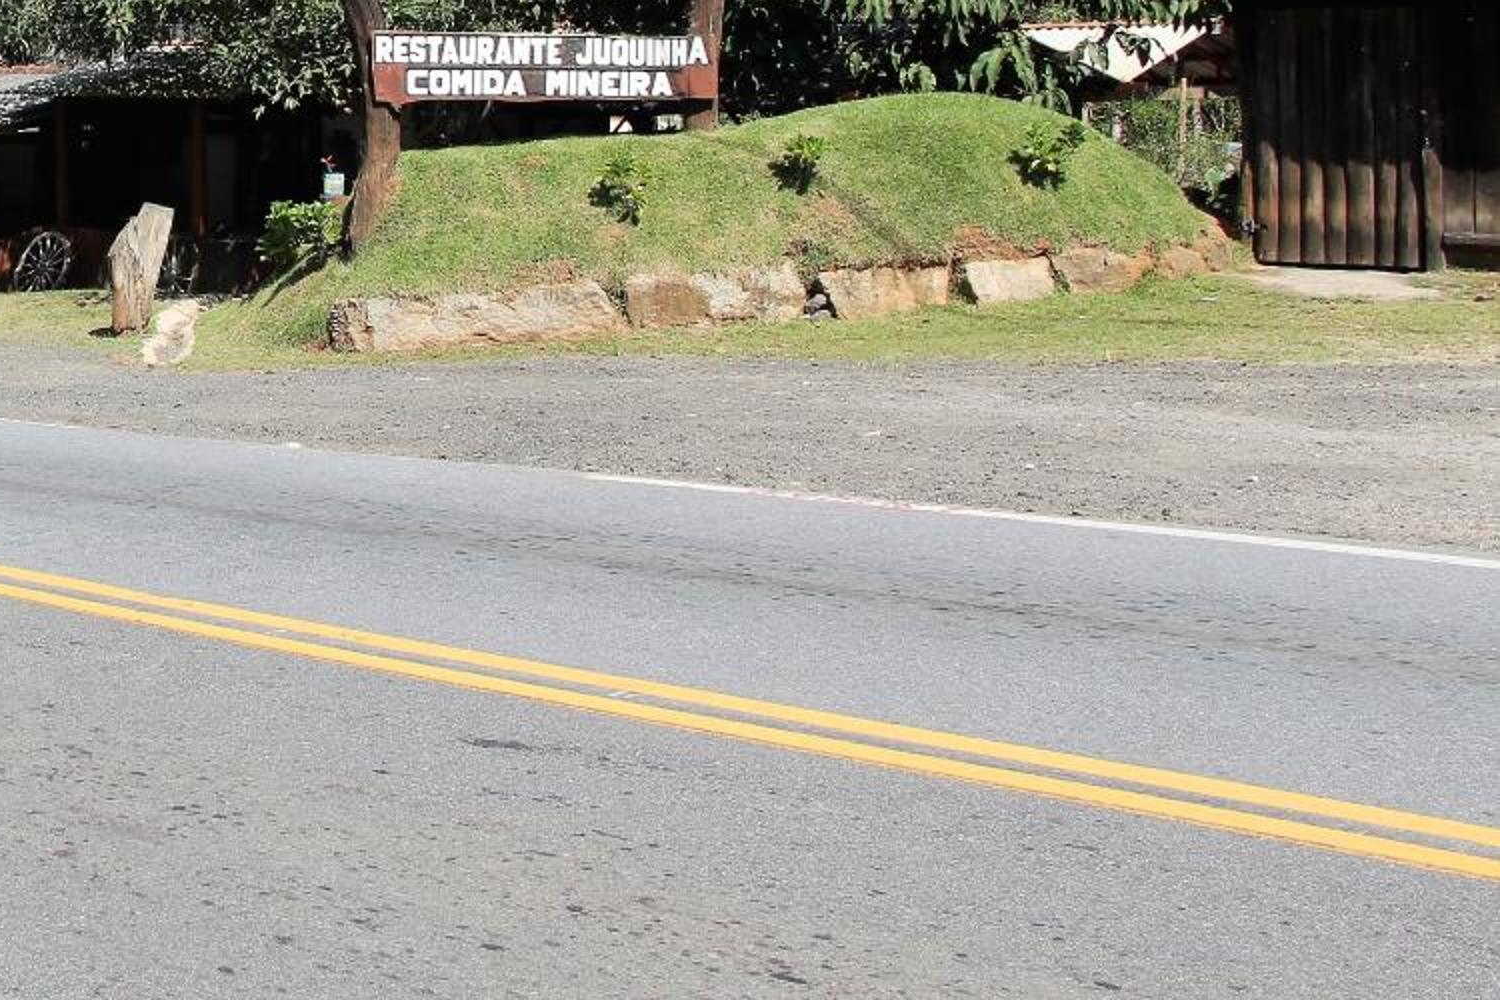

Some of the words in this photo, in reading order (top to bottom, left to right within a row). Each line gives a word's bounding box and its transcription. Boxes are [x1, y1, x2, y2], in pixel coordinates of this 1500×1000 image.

[375, 36, 562, 65] RESTAURANTE
[576, 36, 708, 67] JUQUINHA
[406, 69, 526, 97] COMIDA
[545, 70, 673, 97] MINEIRA
